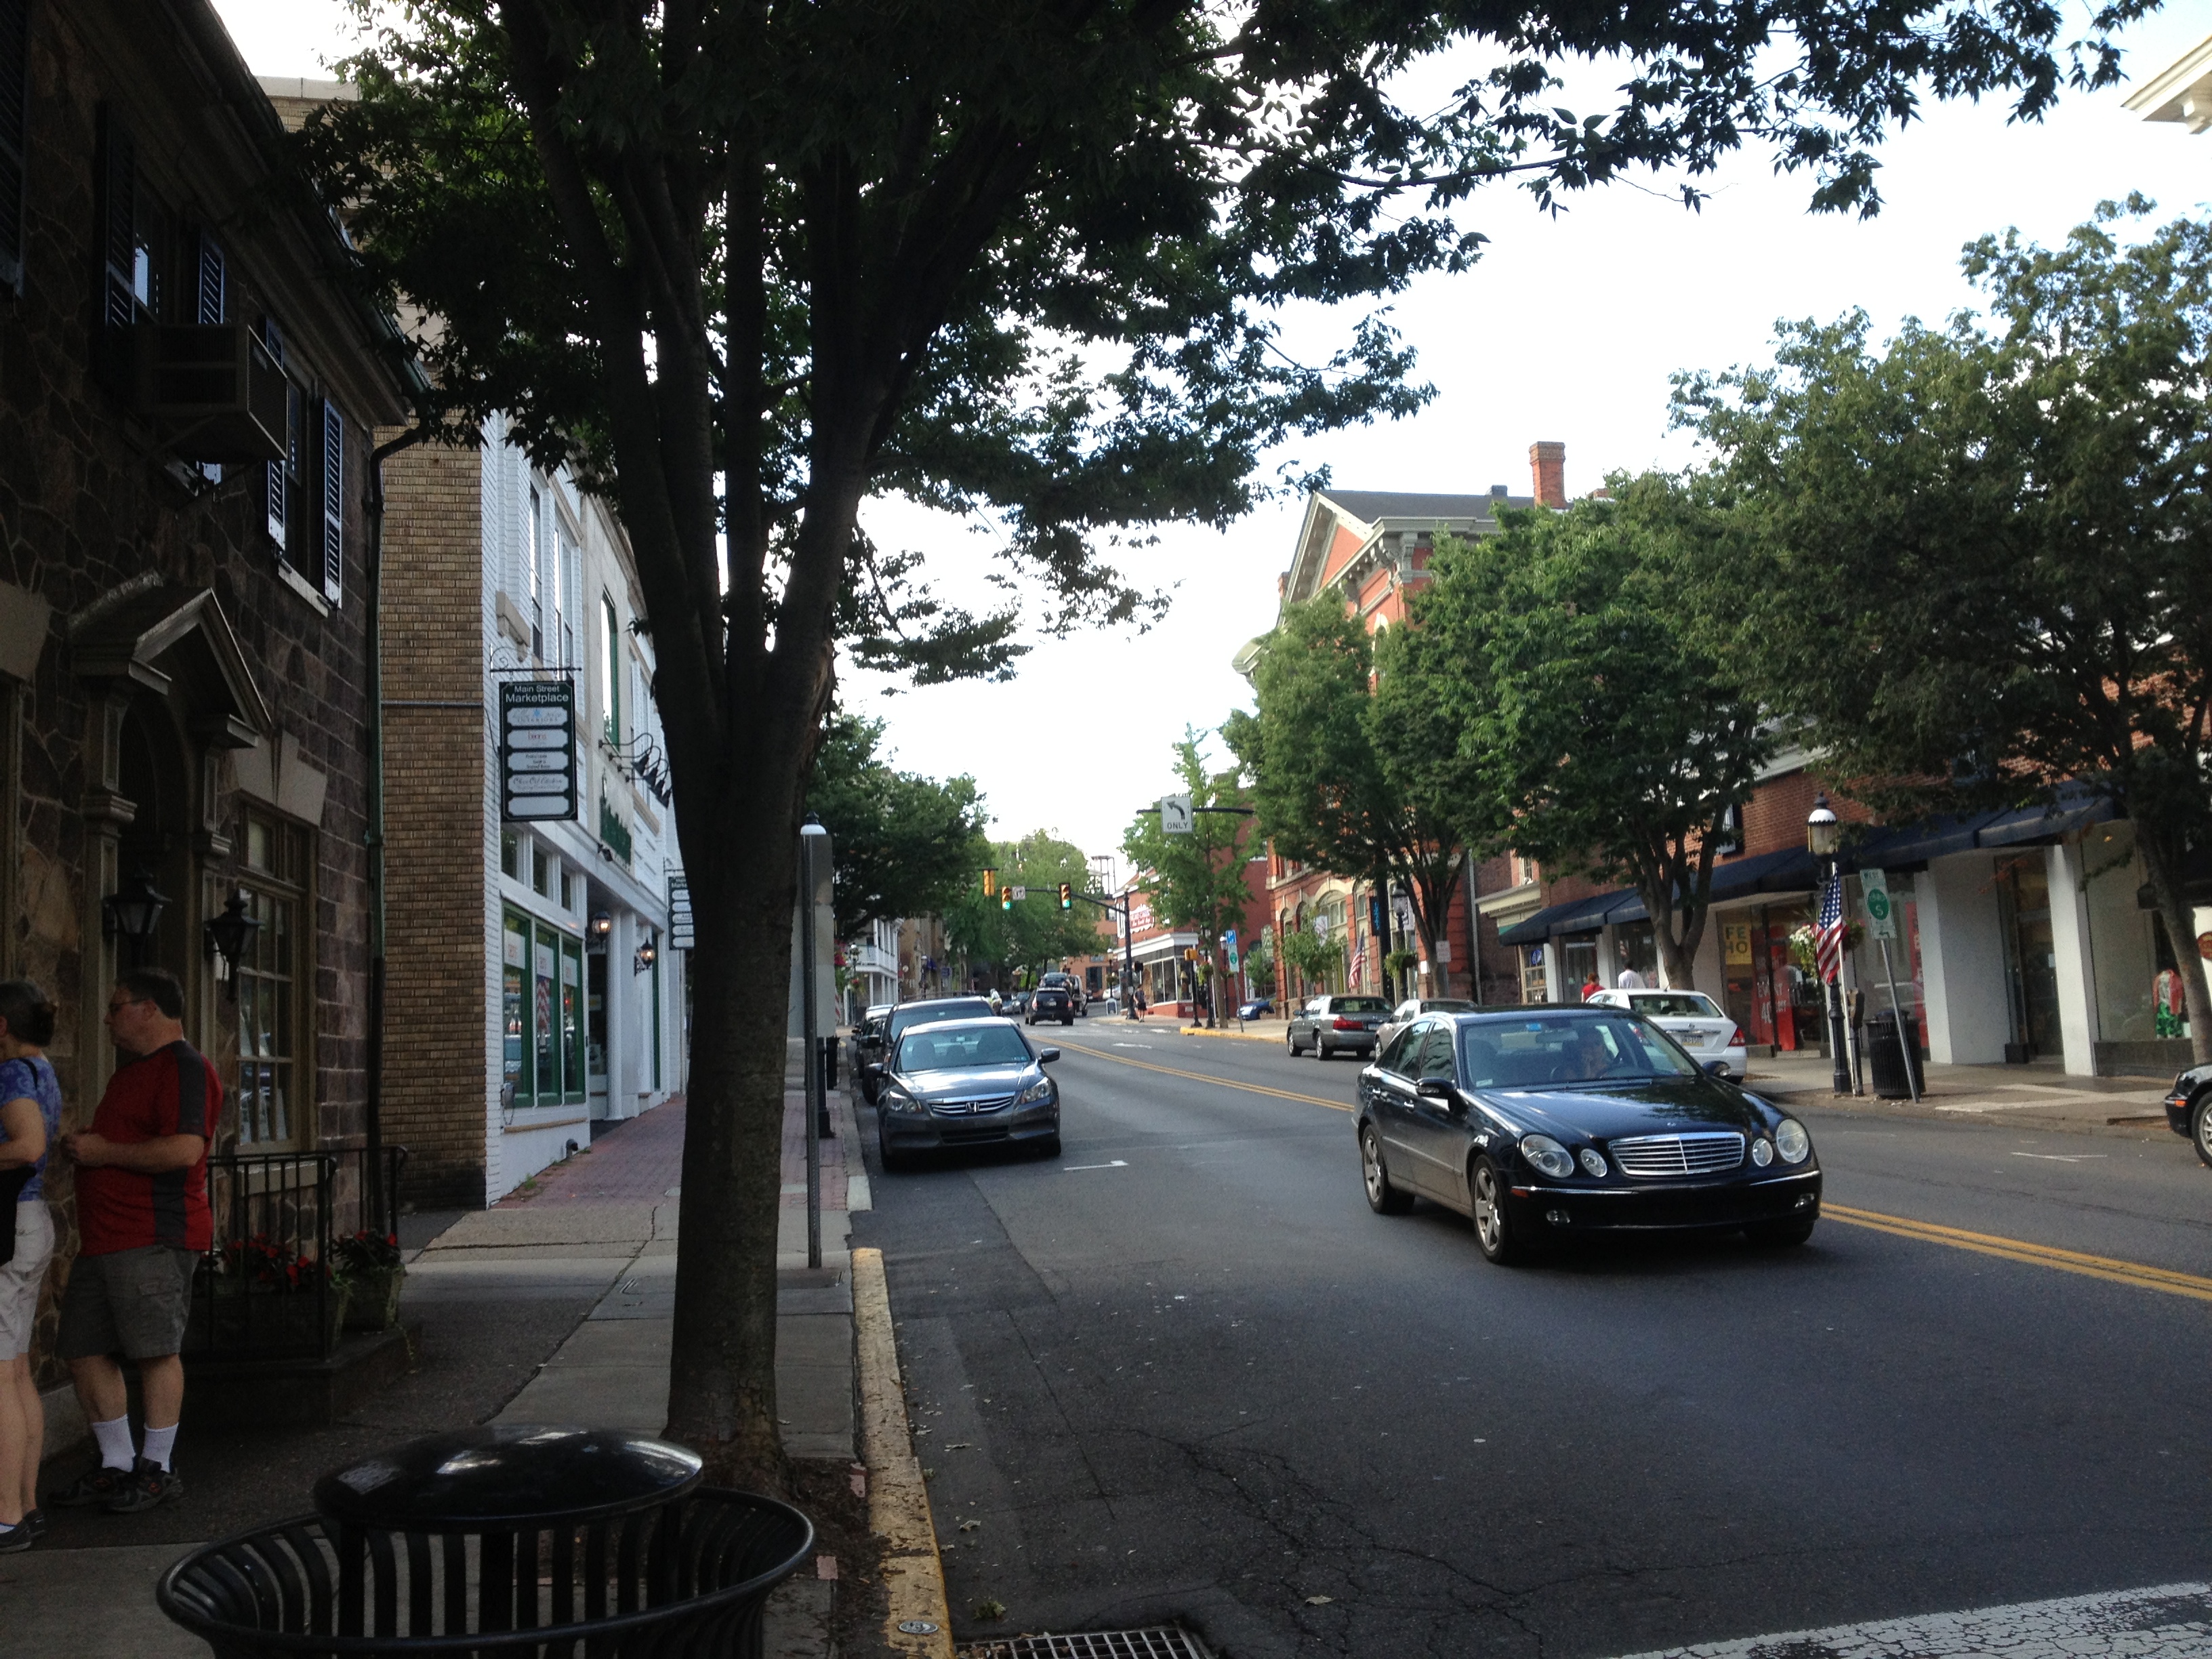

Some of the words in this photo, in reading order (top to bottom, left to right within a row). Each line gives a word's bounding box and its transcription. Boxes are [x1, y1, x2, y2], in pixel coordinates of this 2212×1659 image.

[514, 685, 534, 693] Main
[536, 684, 560, 693] Street
[506, 693, 569, 704] Marketplace
[1167, 821, 1188, 830] ONLY
[1875, 904, 1884, 916] S
